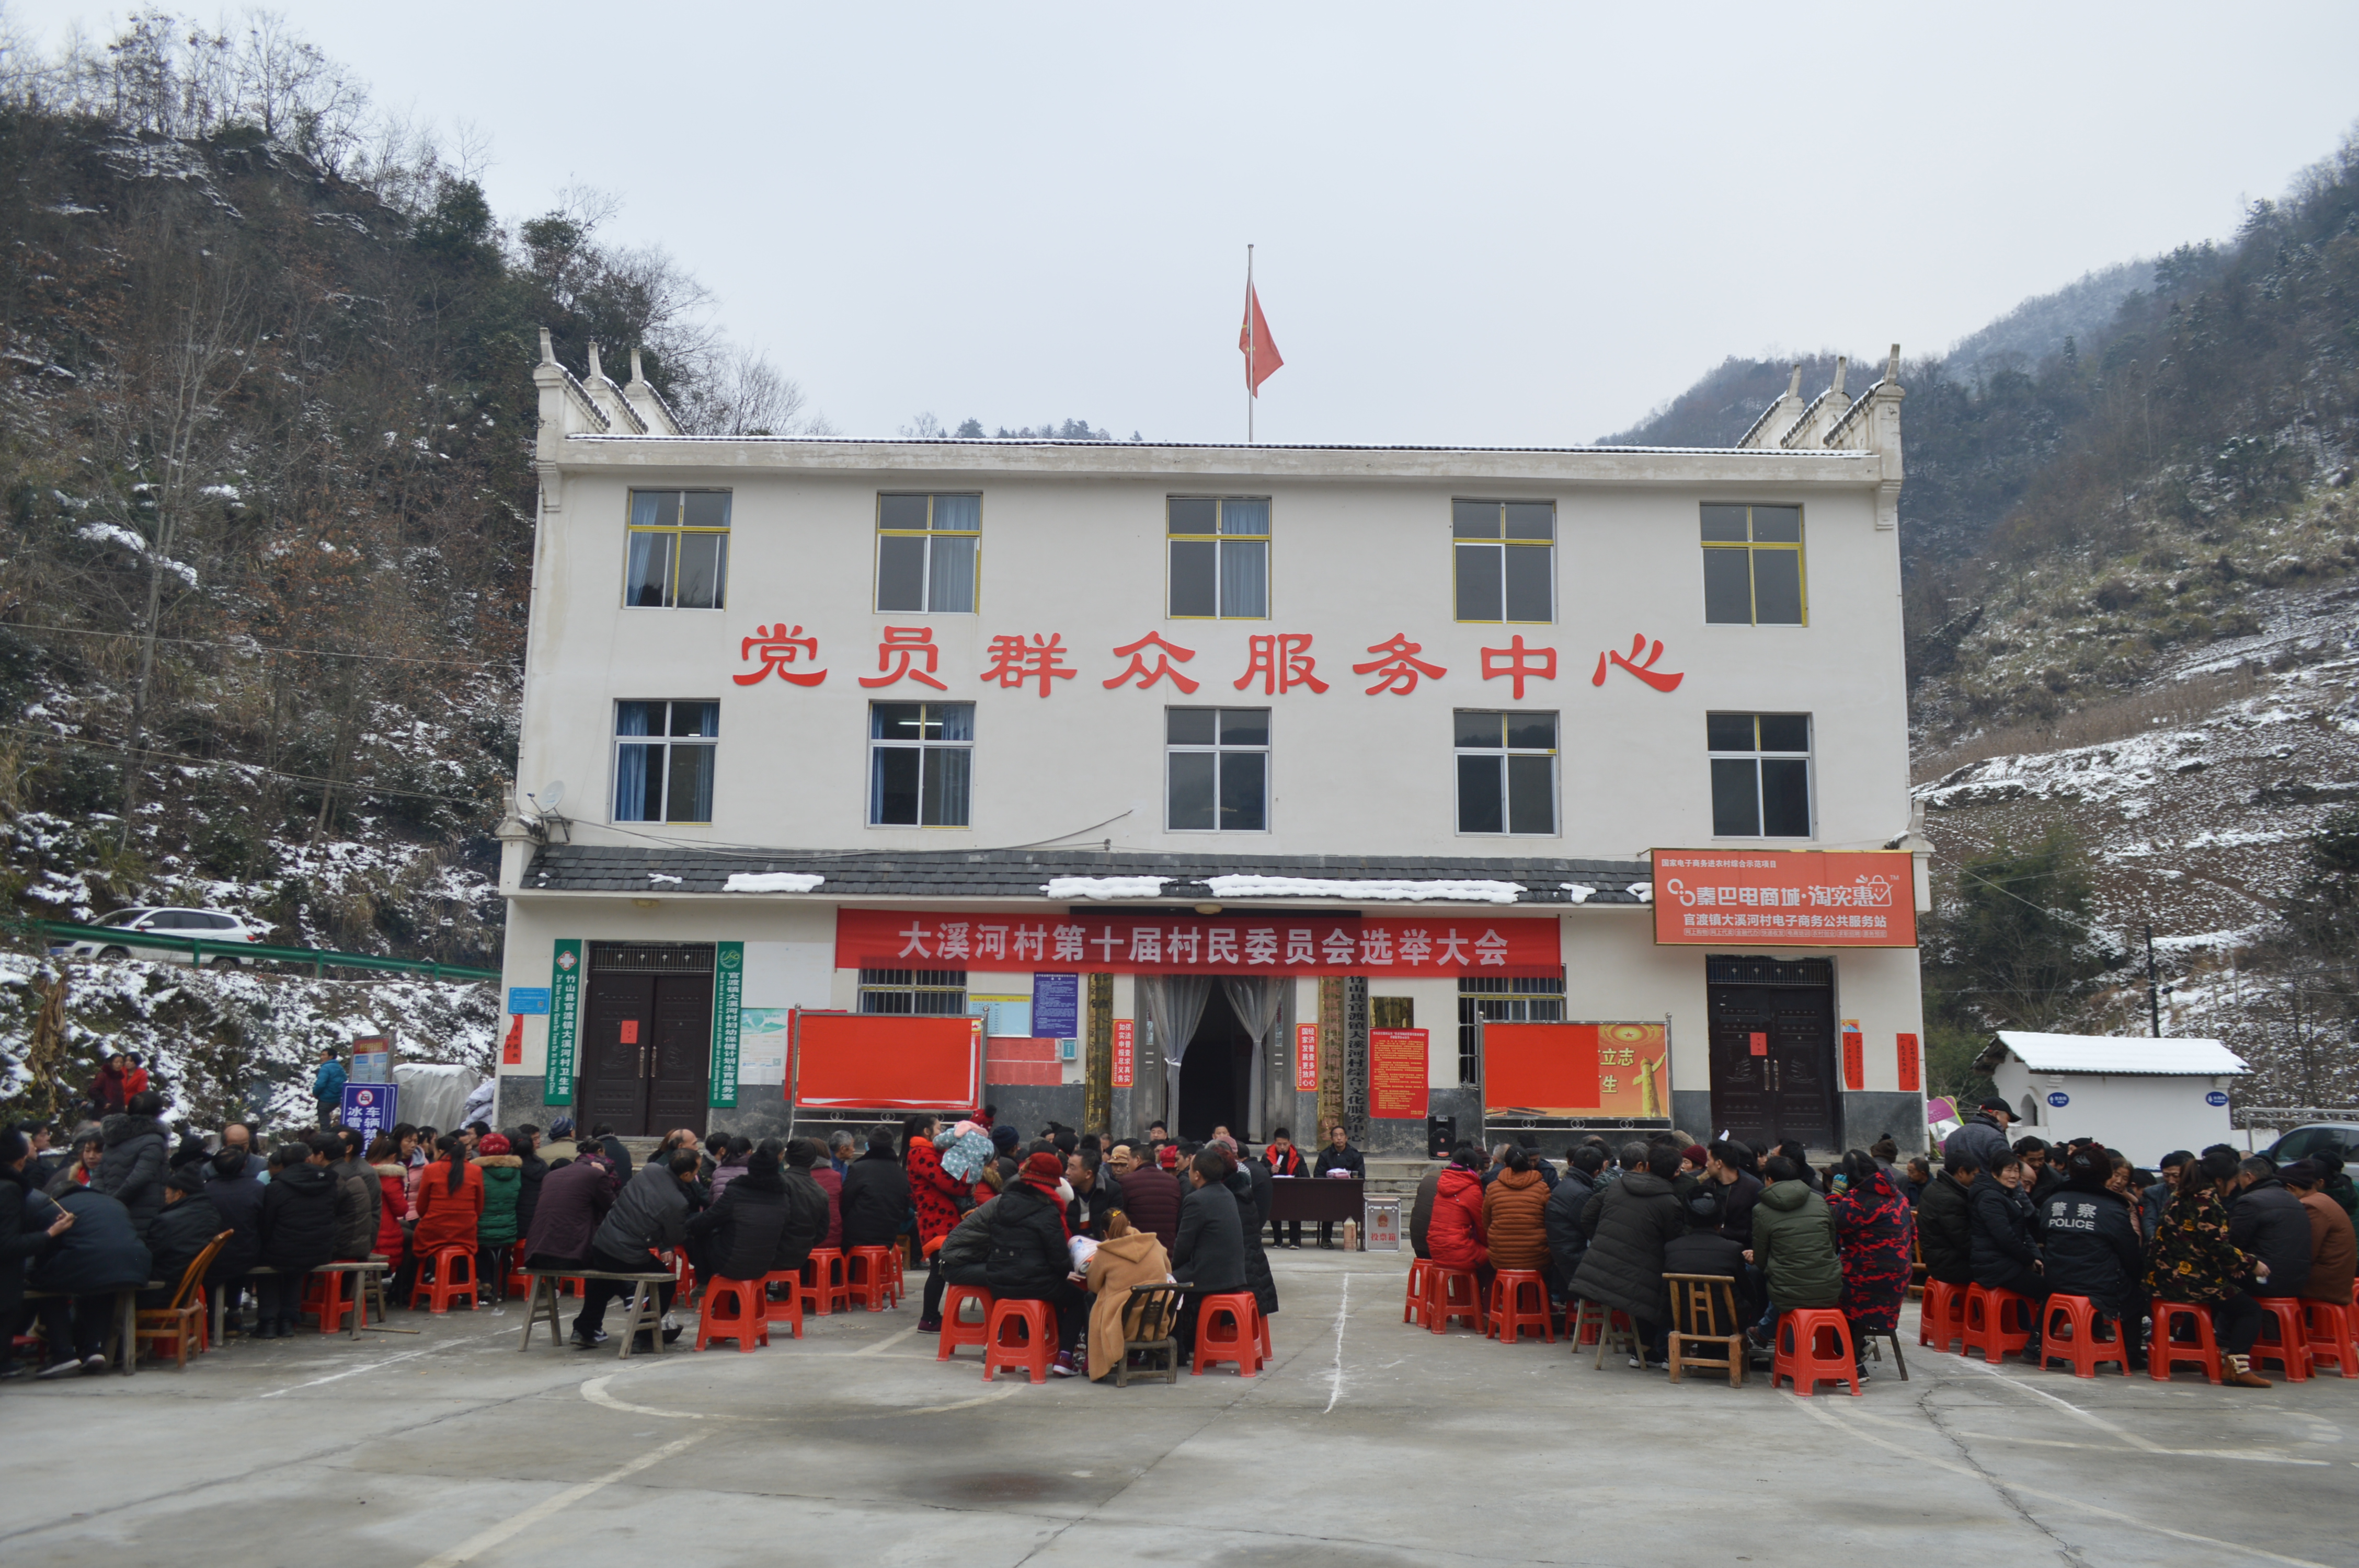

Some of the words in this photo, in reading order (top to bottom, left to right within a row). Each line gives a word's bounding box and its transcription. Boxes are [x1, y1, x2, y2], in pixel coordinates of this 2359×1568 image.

[731, 623, 1686, 700] 党员群众服务中心
[1662, 859, 1777, 868] 国家电子商务进农村综合示范项目
[1684, 913, 1887, 928] 官渡镇大溪河村电子商务公共服务站
[898, 920, 1509, 966] 大溪河村第十届村民委员会选举大会
[558, 975, 577, 1095] 竹山县官渡镇大溪河村卫生室
[721, 972, 740, 1100] 官渡镇大溪河村妇幼保健计划生育服务室
[1347, 976, 1365, 1142] 竹山县官渡镇大溪河村综合文化服务中心
[1598, 1047, 1635, 1066] 立志
[1598, 1075, 1618, 1093] 生
[347, 1106, 363, 1132] 冰雪
[2051, 1201, 2097, 1218] 警察
[2048, 1218, 2095, 1230] POLICE
[1371, 1232, 1396, 1241] 投票箱
